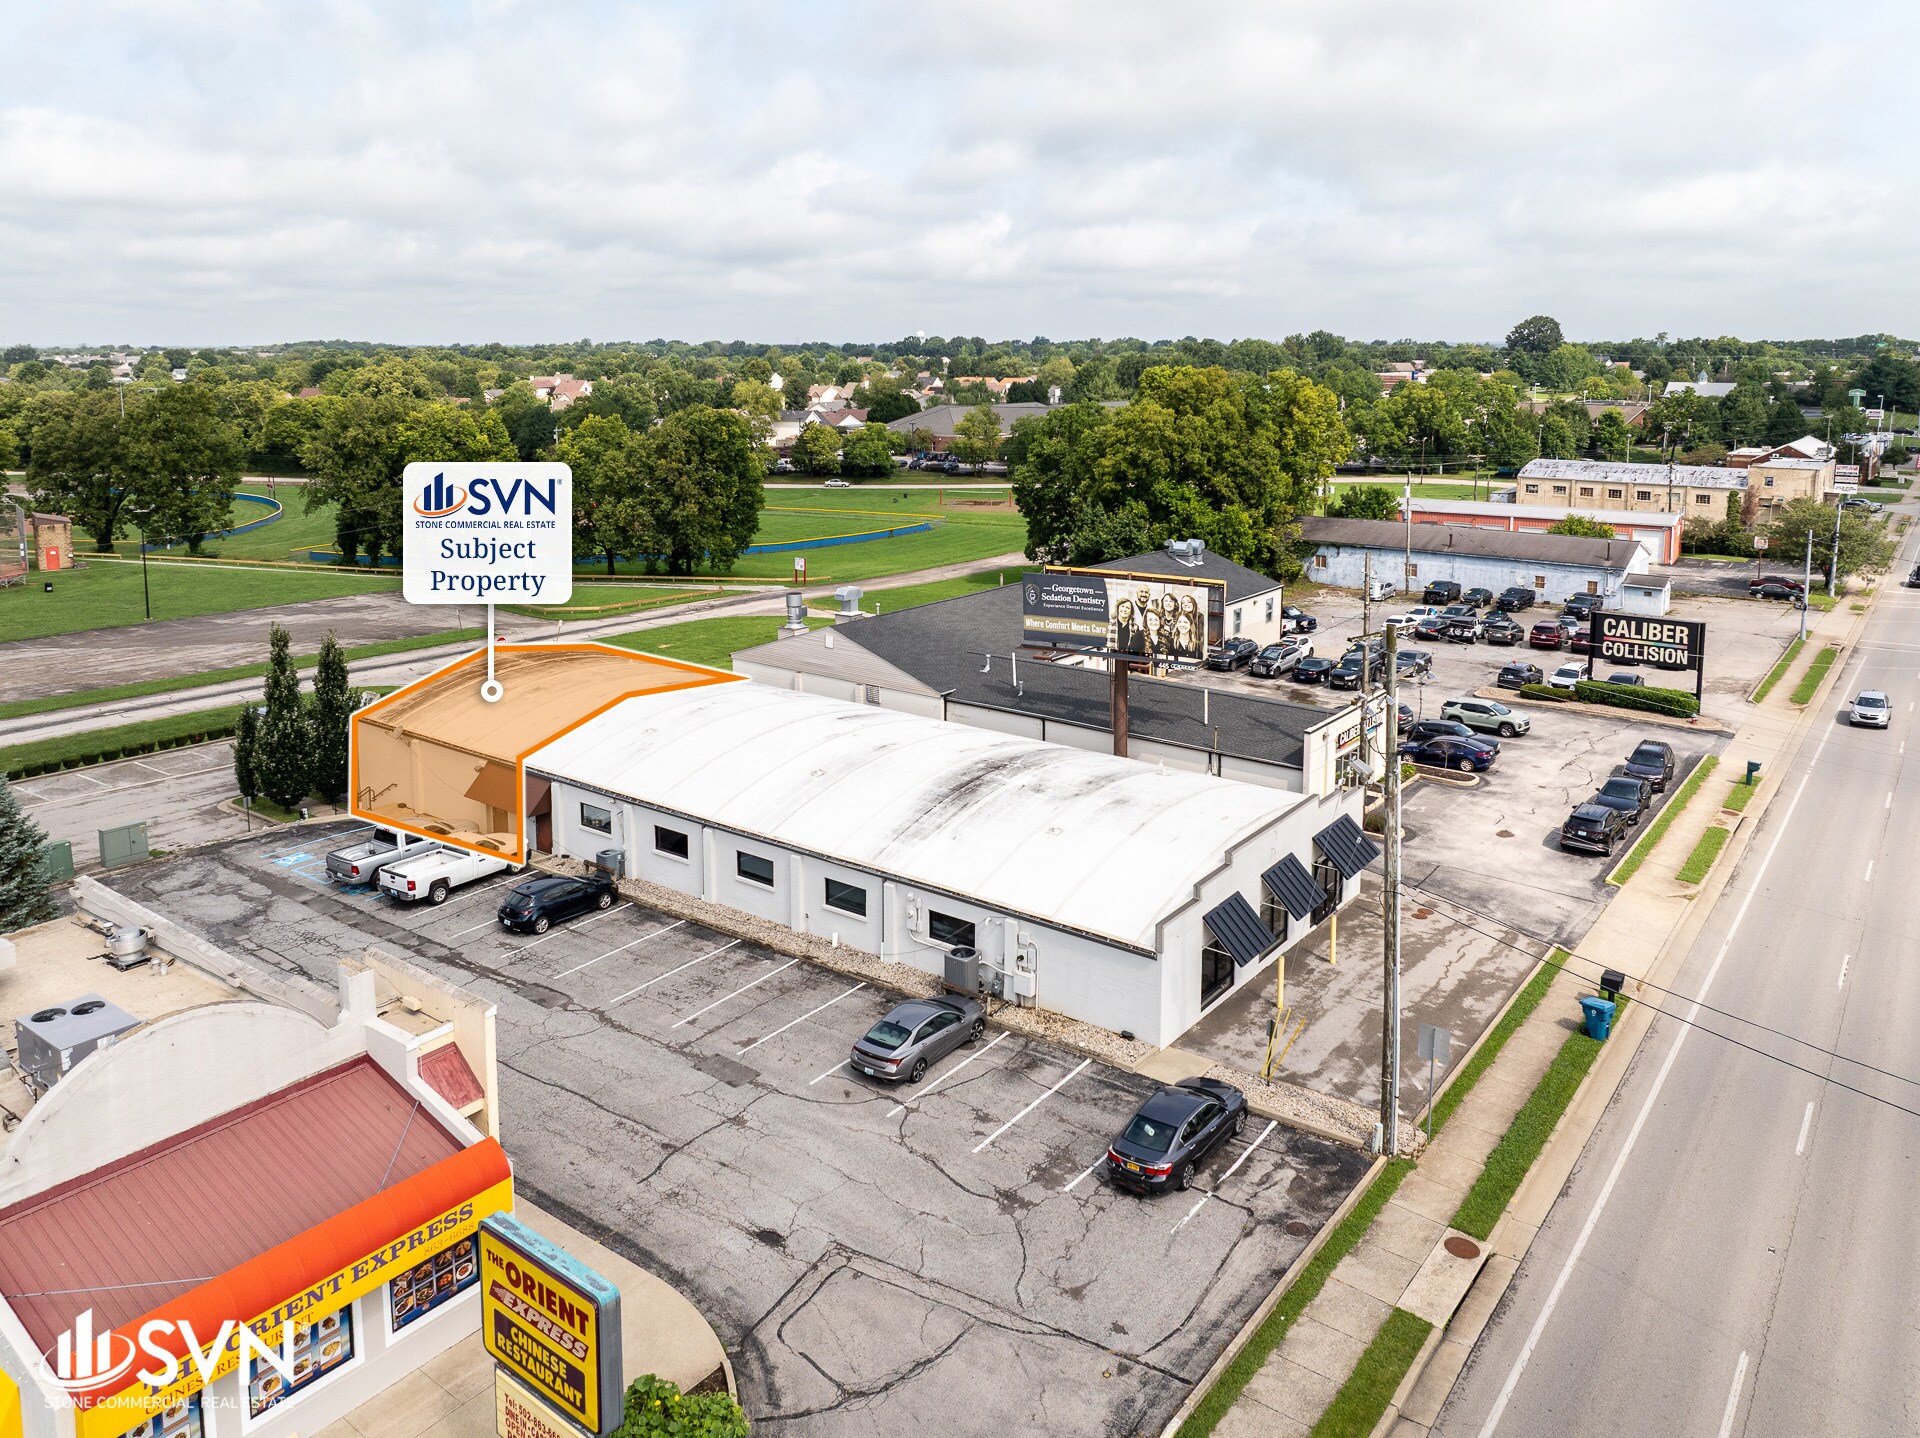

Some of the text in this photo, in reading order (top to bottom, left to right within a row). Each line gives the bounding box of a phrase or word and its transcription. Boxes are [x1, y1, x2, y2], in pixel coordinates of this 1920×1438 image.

[1041, 592, 1106, 607] Sedation Dentistry
[1051, 583, 1095, 595] Georgetown
[1025, 618, 1107, 634] Where Comfort Meets Care
[1603, 618, 1689, 645] CALIBER
[1602, 641, 1688, 665] COLLISION
[423, 1221, 475, 1257] 863-6688
[486, 1248, 505, 1271] THE
[225, 1273, 345, 1352] ORIENT
[350, 1202, 474, 1284] EXPRESS
[505, 1261, 590, 1337] ORIENT
[502, 1288, 589, 1360] EXPRESS
[510, 1327, 568, 1378] CHINESE
[497, 1331, 583, 1409] RESTAURANT
[504, 1392, 518, 1410] Tel:
